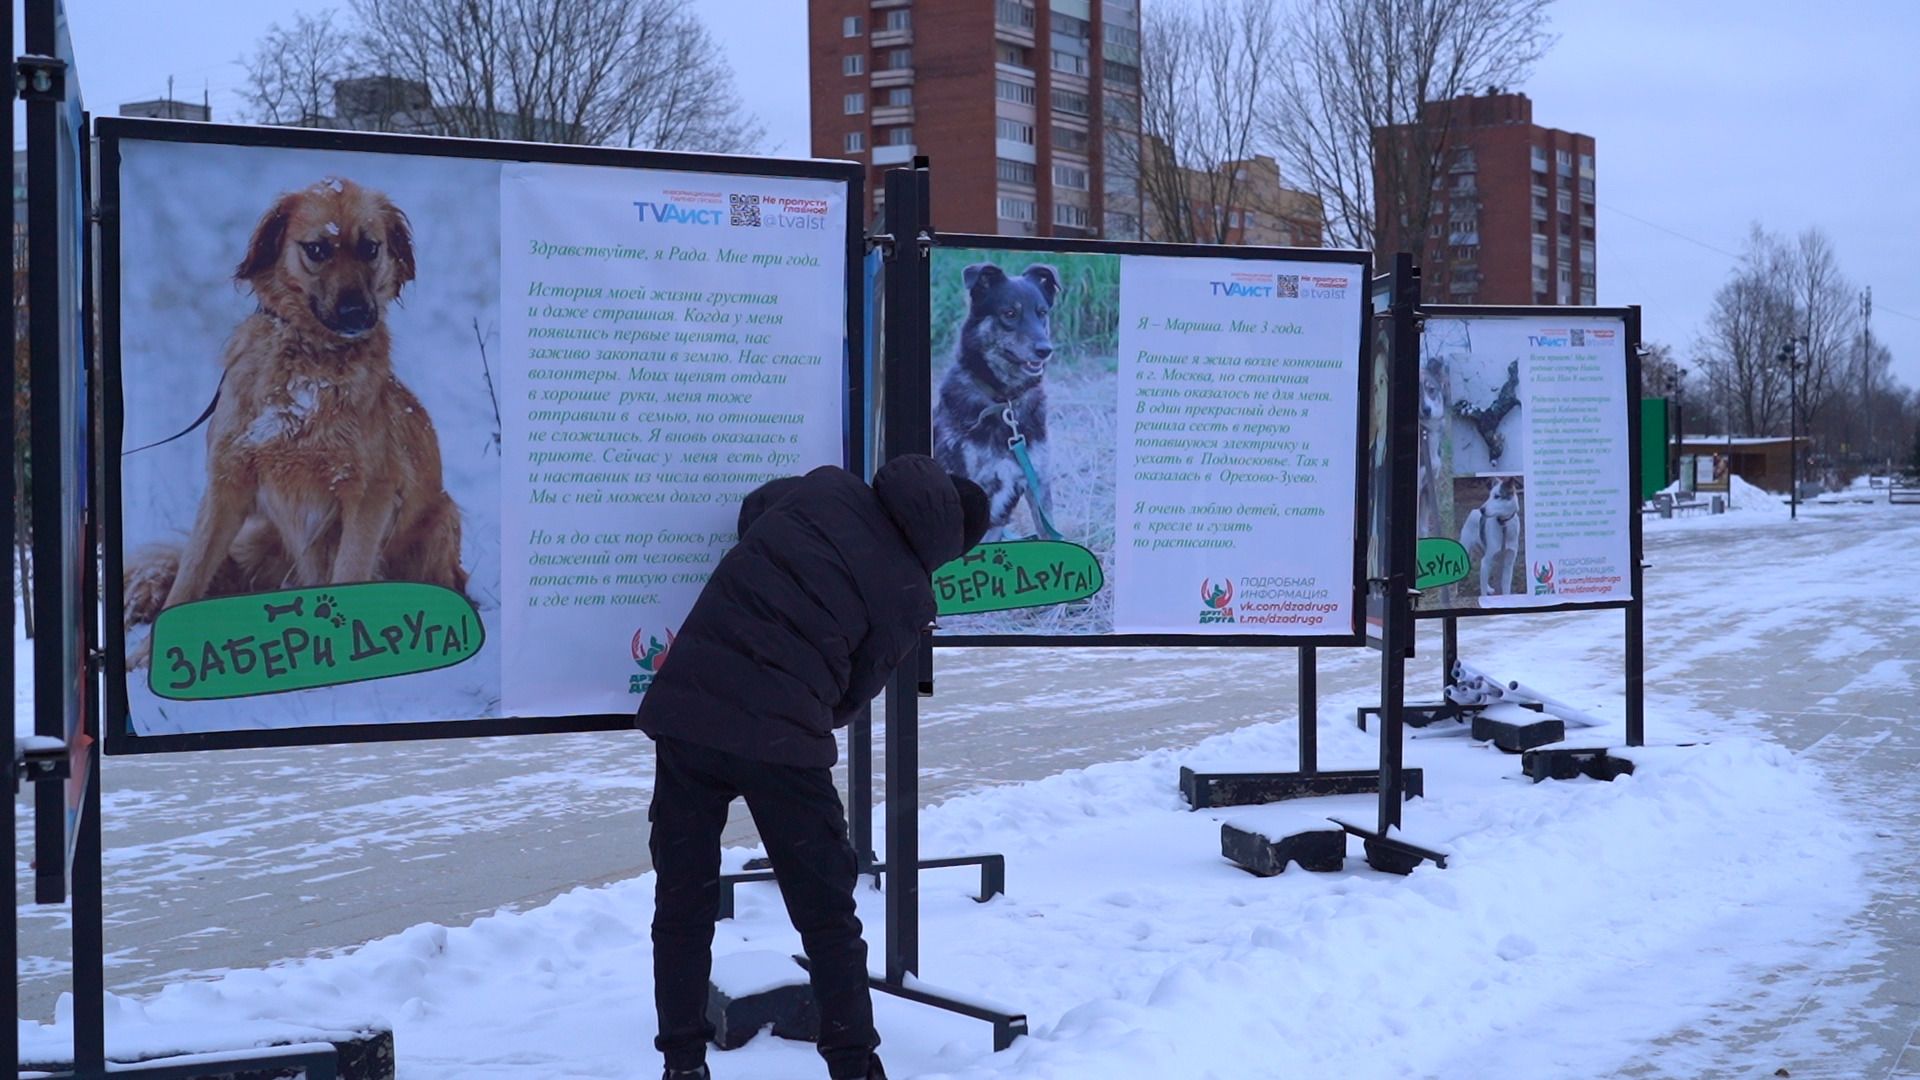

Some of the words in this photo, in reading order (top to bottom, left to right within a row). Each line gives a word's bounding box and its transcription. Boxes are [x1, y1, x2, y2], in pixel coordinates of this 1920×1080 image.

[763, 196, 776, 204] Не
[779, 198, 827, 207] пропусти
[528, 240, 648, 260] Здравствуйте,
[668, 246, 708, 262] Рада.
[715, 248, 748, 263] Мне
[751, 254, 783, 268] три
[786, 254, 821, 266] года.
[528, 282, 603, 302] История
[608, 286, 646, 300] моей
[650, 290, 702, 302] жизни
[707, 292, 778, 306] грустная
[543, 304, 589, 319] даже
[593, 308, 676, 324] страшная.
[684, 307, 730, 323] Когда
[746, 314, 783, 324] меня
[1164, 318, 1224, 333] Мариша.
[1229, 320, 1257, 333] Мне
[1272, 322, 1304, 335] года.
[528, 328, 609, 340] появились
[613, 330, 670, 344] первые
[674, 332, 739, 345] щенята,
[745, 334, 771, 344] нас
[528, 348, 590, 360] заживо
[596, 350, 666, 362] закопали
[683, 352, 733, 364] землю.
[738, 349, 768, 364] Нас
[773, 354, 821, 366] спасли
[1136, 350, 1188, 364] Раньше
[1203, 355, 1240, 366] жила
[1244, 357, 1279, 367] возле
[1282, 359, 1343, 368] конюшни
[528, 369, 619, 384] волонтеры.
[628, 367, 669, 382] Моих
[674, 372, 726, 386] щенят
[731, 370, 787, 384] отдали
[1147, 371, 1156, 380] г.
[1161, 368, 1215, 384] Москва,
[1219, 373, 1234, 382] но
[1239, 374, 1309, 384] столичная
[541, 390, 610, 404] хорошие
[619, 392, 659, 406] руки,
[664, 392, 702, 403] меня
[706, 393, 751, 404] тоже
[1136, 388, 1180, 398] жизнь
[1184, 388, 1250, 400] оказалось
[1254, 391, 1269, 400] не
[1272, 388, 1294, 400] для
[1298, 392, 1332, 401] меня.
[528, 410, 616, 425] отправили
[638, 412, 691, 424] семью,
[696, 413, 715, 423] но
[718, 413, 805, 424] отношения
[1149, 402, 1181, 414] один
[1185, 404, 1266, 418] прекрасный
[1268, 404, 1297, 416] день
[1134, 421, 1185, 434] решила
[1190, 422, 1228, 432] сесть
[1243, 424, 1290, 436] первую
[528, 432, 547, 442] не
[551, 432, 642, 443] сложились.
[666, 432, 708, 443] вновь
[712, 433, 787, 444] оказалась
[1135, 438, 1218, 451] попавшуюся
[1222, 440, 1299, 453] электричку
[528, 452, 596, 466] приюте.
[603, 448, 660, 464] Сейчас
[680, 453, 718, 464] меня
[727, 453, 763, 463] есть
[768, 450, 800, 467] друг
[1133, 455, 1183, 467] уехать
[1200, 453, 1290, 466] Подмосковье.
[1297, 454, 1318, 467] Так
[543, 472, 629, 484] наставник
[634, 473, 651, 483] из
[656, 472, 698, 483] числа
[1134, 472, 1201, 481] оказалась
[1219, 469, 1317, 486] Орехово-Зуево.
[529, 488, 558, 504] Мы
[576, 493, 602, 503] ней
[609, 493, 665, 503] можем
[670, 489, 711, 503] долго
[1148, 505, 1185, 514] очень
[1190, 502, 1232, 516] люблю
[1236, 503, 1280, 516] детей,
[1284, 507, 1325, 516] спать
[1148, 522, 1194, 534] кресле
[1208, 522, 1252, 534] гулять
[529, 530, 552, 544] Но
[571, 530, 589, 544] до
[594, 534, 620, 544] сих
[625, 533, 652, 548] пор
[657, 529, 704, 544] боюсь
[1133, 538, 1149, 548] по
[1152, 538, 1236, 551] расписанию.
[529, 552, 609, 565] движений
[615, 554, 638, 564] от
[643, 552, 713, 564] человека.
[529, 575, 598, 586] попасть
[616, 574, 667, 588] тихую
[935, 569, 1006, 604] БЕРИ
[1014, 561, 1094, 594] ДРУГА!
[1240, 577, 1315, 588] ПОДРОБНАЯ
[543, 591, 570, 607] где
[574, 594, 606, 606] нет
[610, 594, 661, 606] кошек.
[1240, 589, 1328, 600] ИНФОРМАЦИЯ
[1240, 601, 1338, 614] vk.com/dzadruga
[1199, 616, 1235, 624] ДРУГА
[1240, 613, 1323, 626] t.me/dzadruga
[349, 610, 470, 661] ДРУГА!
